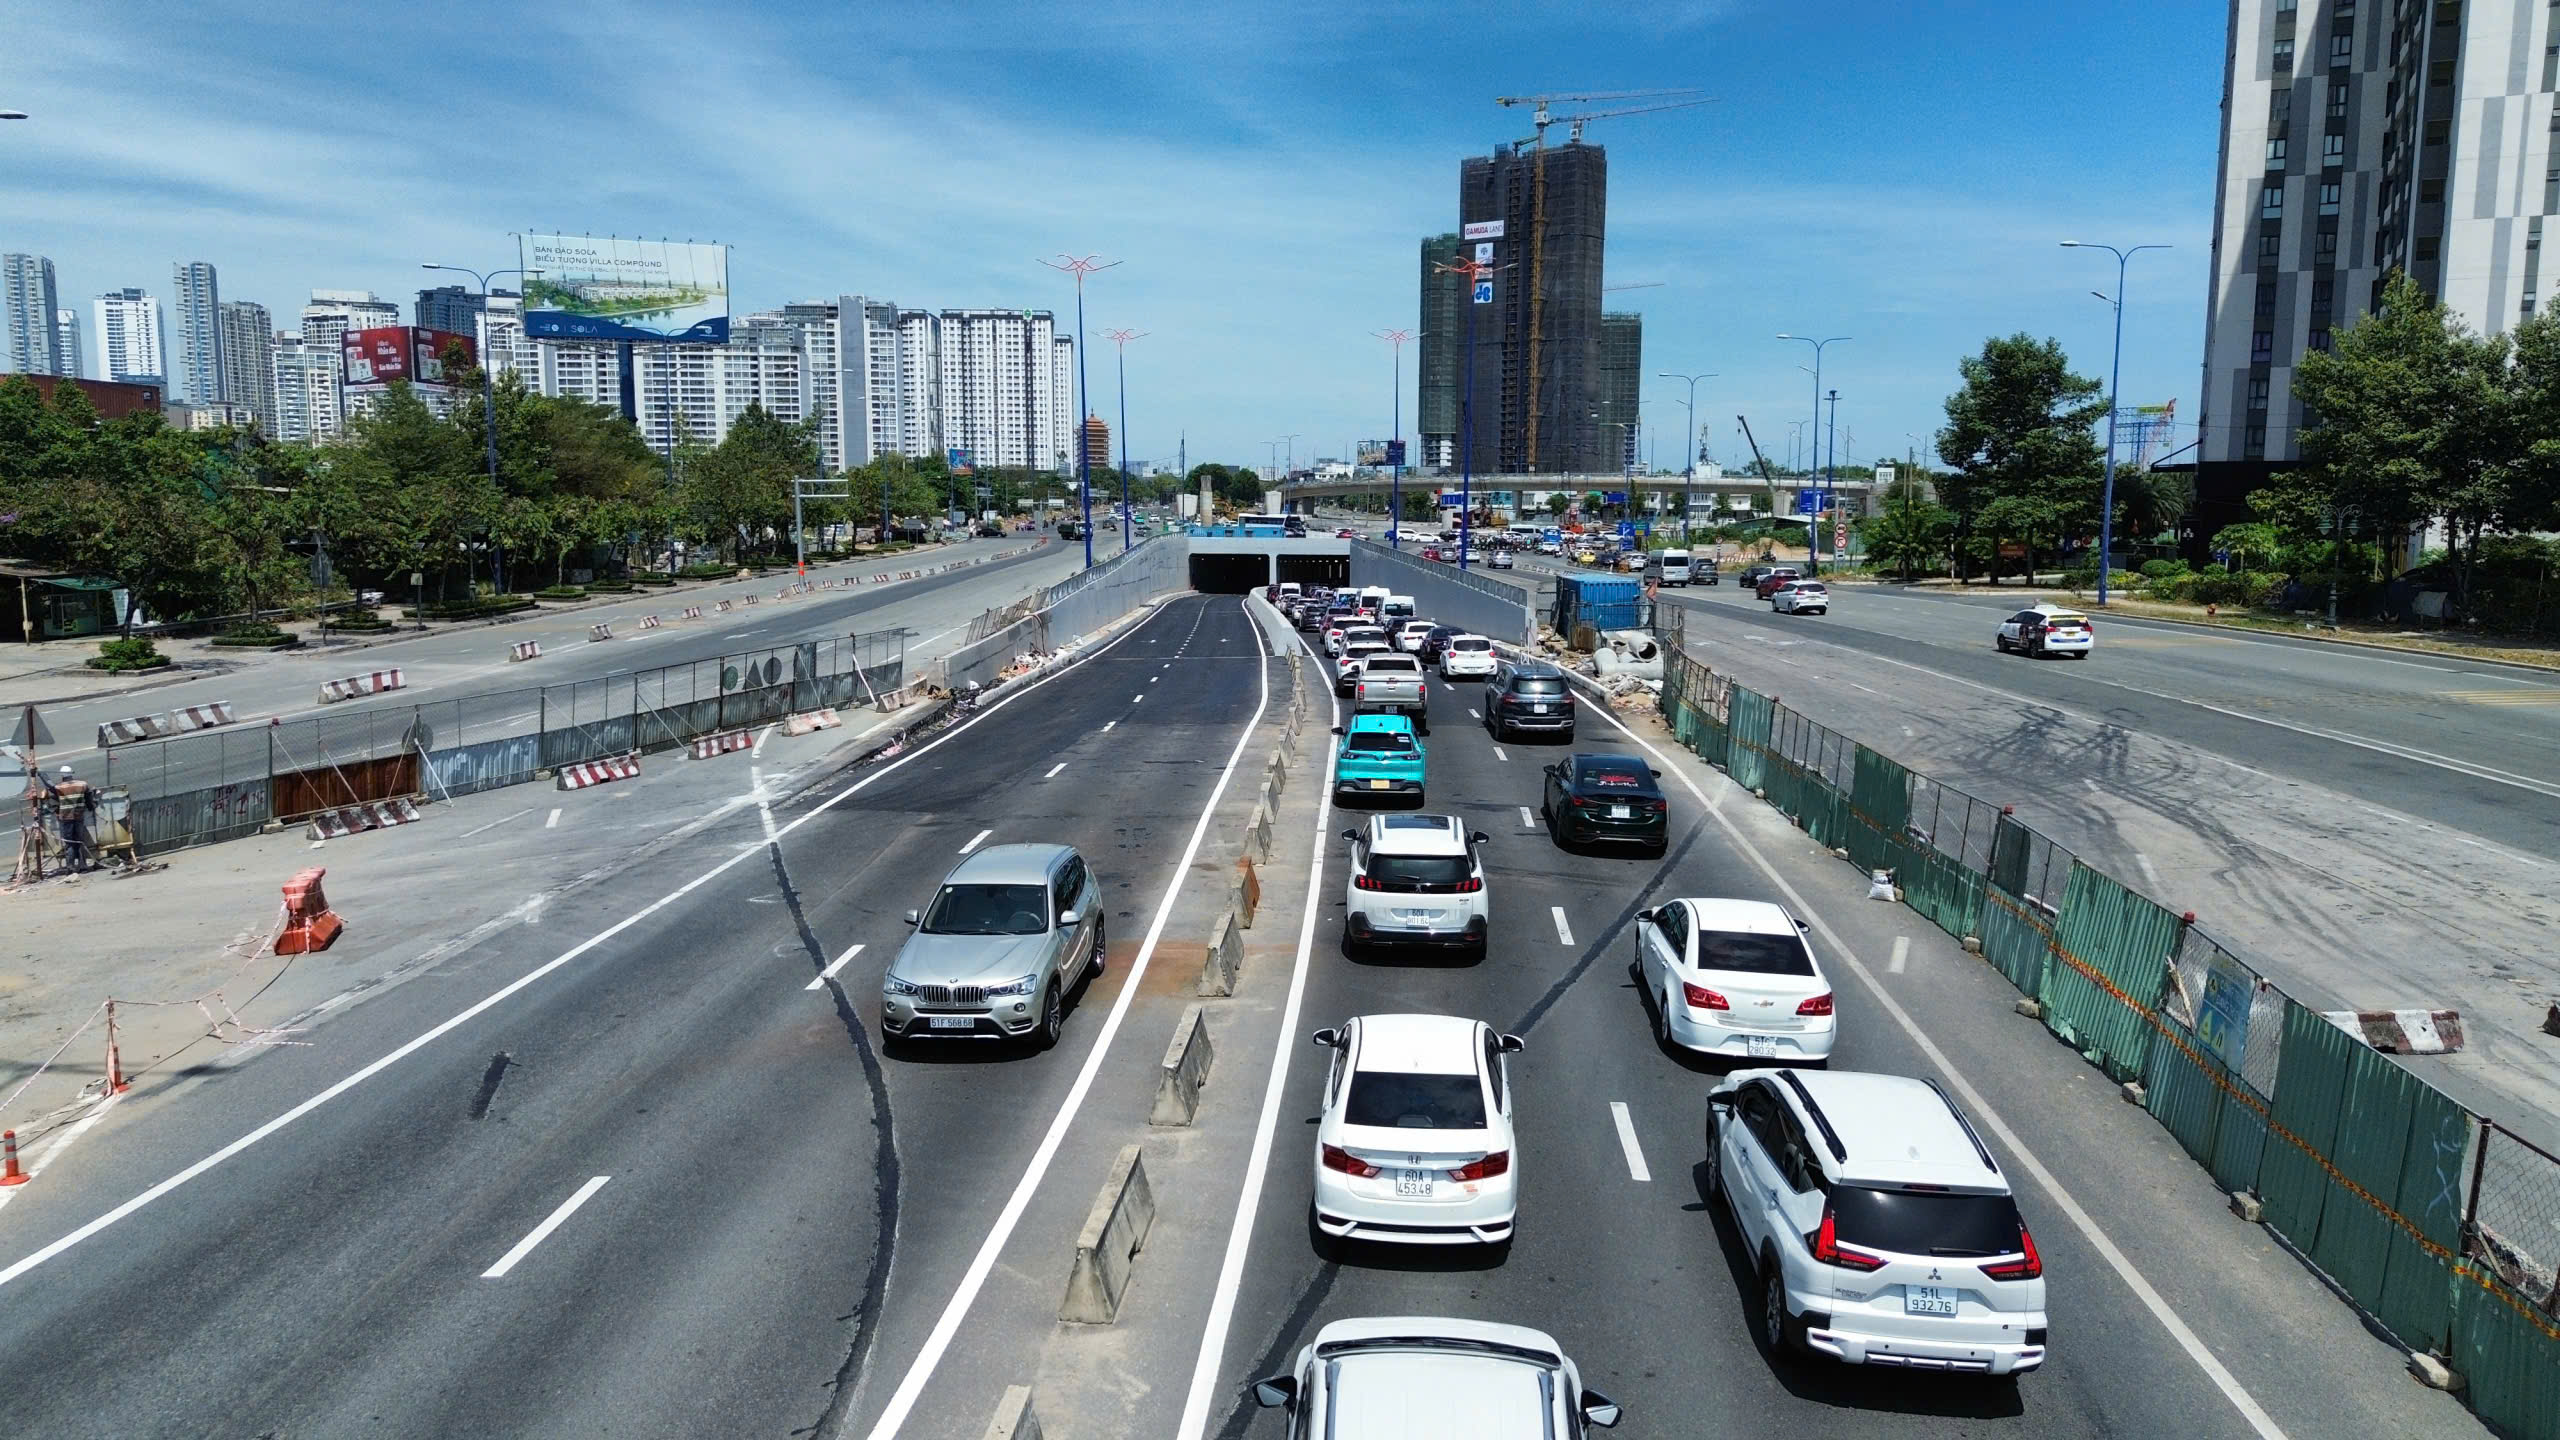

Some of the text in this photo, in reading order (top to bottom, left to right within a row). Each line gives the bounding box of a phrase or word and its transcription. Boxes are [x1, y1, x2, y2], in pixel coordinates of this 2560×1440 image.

[1466, 224, 1503, 236] GAMUDA LAND
[575, 248, 597, 256] SOLA
[590, 258, 612, 266] VILLA
[614, 259, 662, 268] COMPOUND
[571, 324, 598, 333] SOLA
[931, 1018, 945, 1027] 51F
[1405, 1169, 1424, 1182] 60A
[1398, 1182, 1431, 1195] 453.48
[1920, 1287, 1943, 1299] 51L
[1912, 1299, 1952, 1312] 932.76
